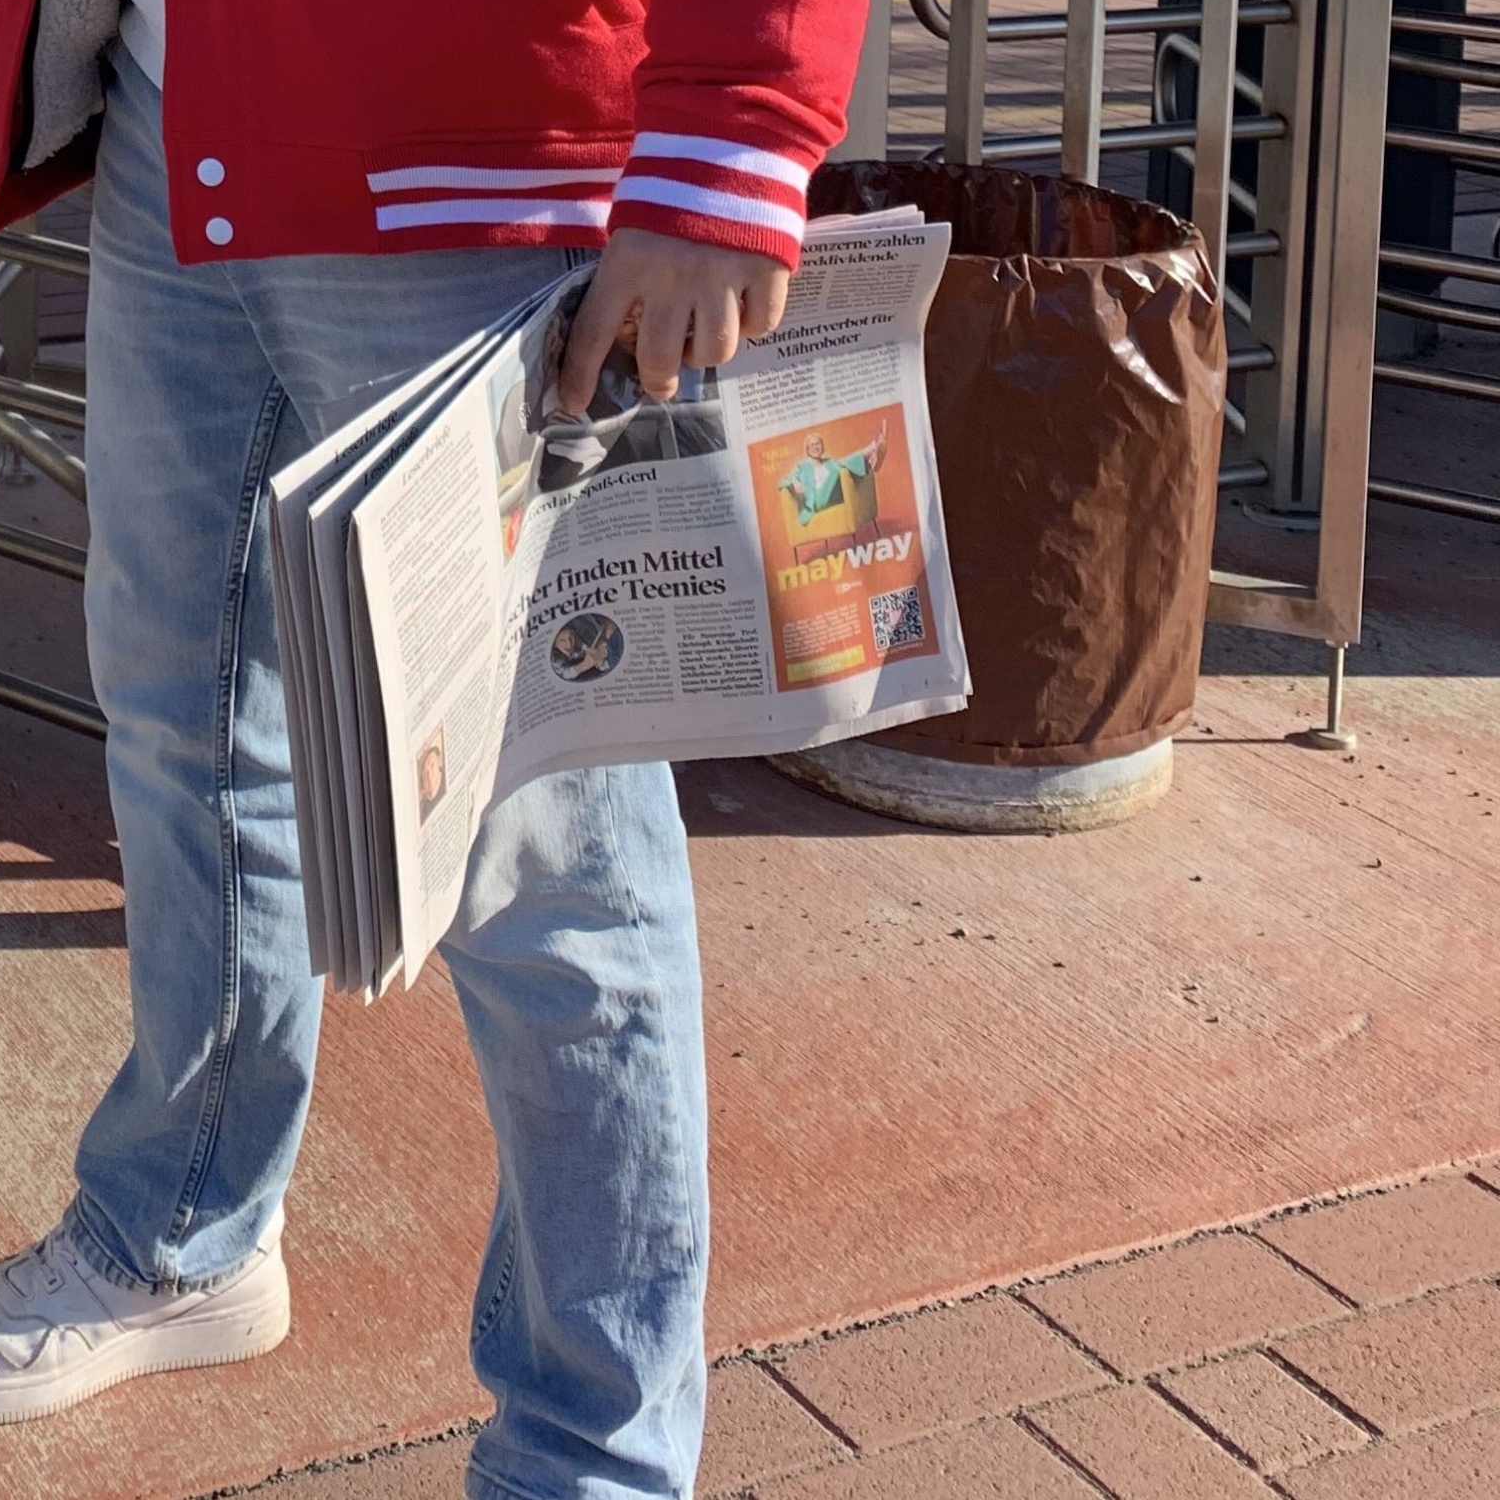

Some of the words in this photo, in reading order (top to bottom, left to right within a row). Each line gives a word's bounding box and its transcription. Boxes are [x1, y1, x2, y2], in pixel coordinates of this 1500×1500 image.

[800, 238, 872, 254] konzerne
[874, 234, 926, 248] zahlen
[746, 314, 868, 350] Nachtfahrtverbot
[871, 312, 895, 325] für
[777, 332, 862, 360] Mähroboter
[335, 409, 398, 464] Leserbriefe
[402, 424, 451, 487] Leserbriefe
[556, 551, 638, 594] finden
[643, 546, 724, 573] Mittel
[777, 531, 913, 592] mayway
[526, 585, 618, 639] gereizte
[622, 574, 727, 601] Teenies
